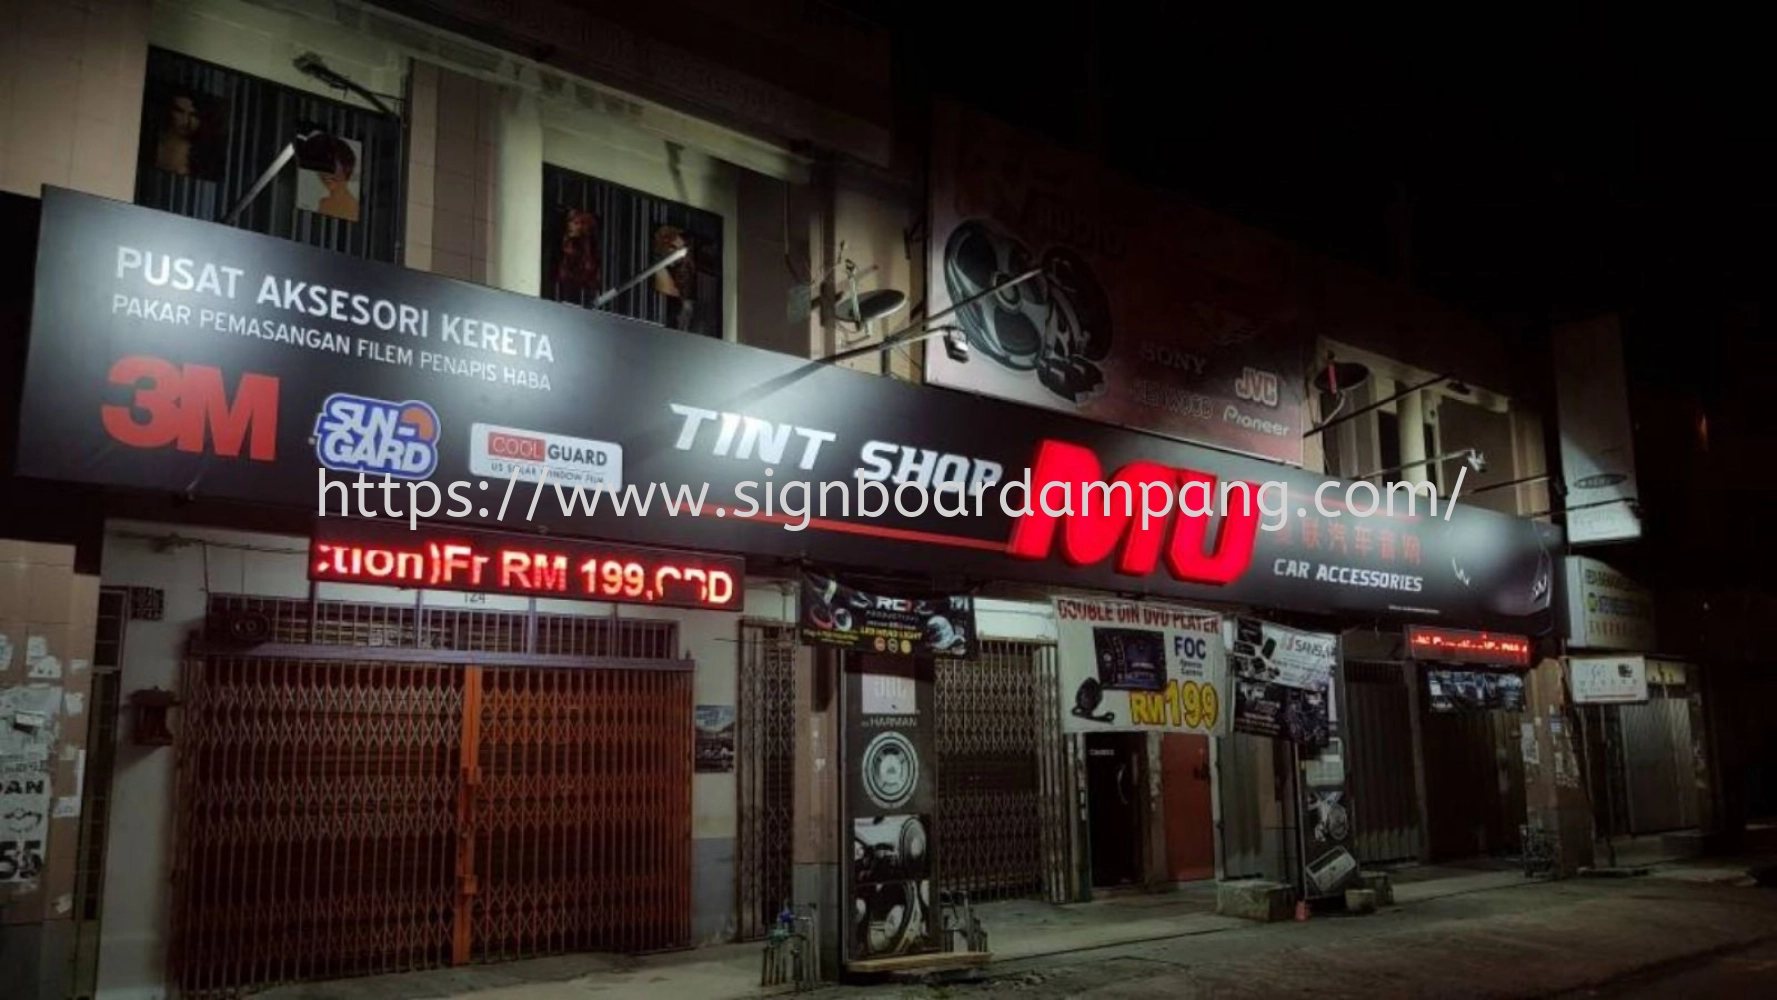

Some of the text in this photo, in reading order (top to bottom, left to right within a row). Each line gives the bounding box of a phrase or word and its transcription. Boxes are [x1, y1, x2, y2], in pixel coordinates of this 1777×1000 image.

[116, 246, 554, 363] PUSAT AKSESORI KERETA
[112, 294, 551, 391] PAKAR PEMASANGAN FILEM PENAPIS HABA
[1139, 341, 1207, 375] SONY
[1235, 367, 1278, 407] JVC
[102, 355, 279, 462] 3M
[1223, 405, 1290, 437] Pioneer
[324, 431, 431, 473] GARD
[491, 462, 503, 472] US
[492, 436, 607, 467] COOL GUARD
[670, 403, 1003, 497] TINT SHOP
[1009, 437, 1263, 586] MU
[502, 549, 568, 591] RM
[1273, 558, 1423, 593] CAR ACCESSORIES
[1058, 600, 1114, 621] DOUBLE
[1173, 612, 1219, 634] PLAYER
[1174, 635, 1206, 660] FOC
